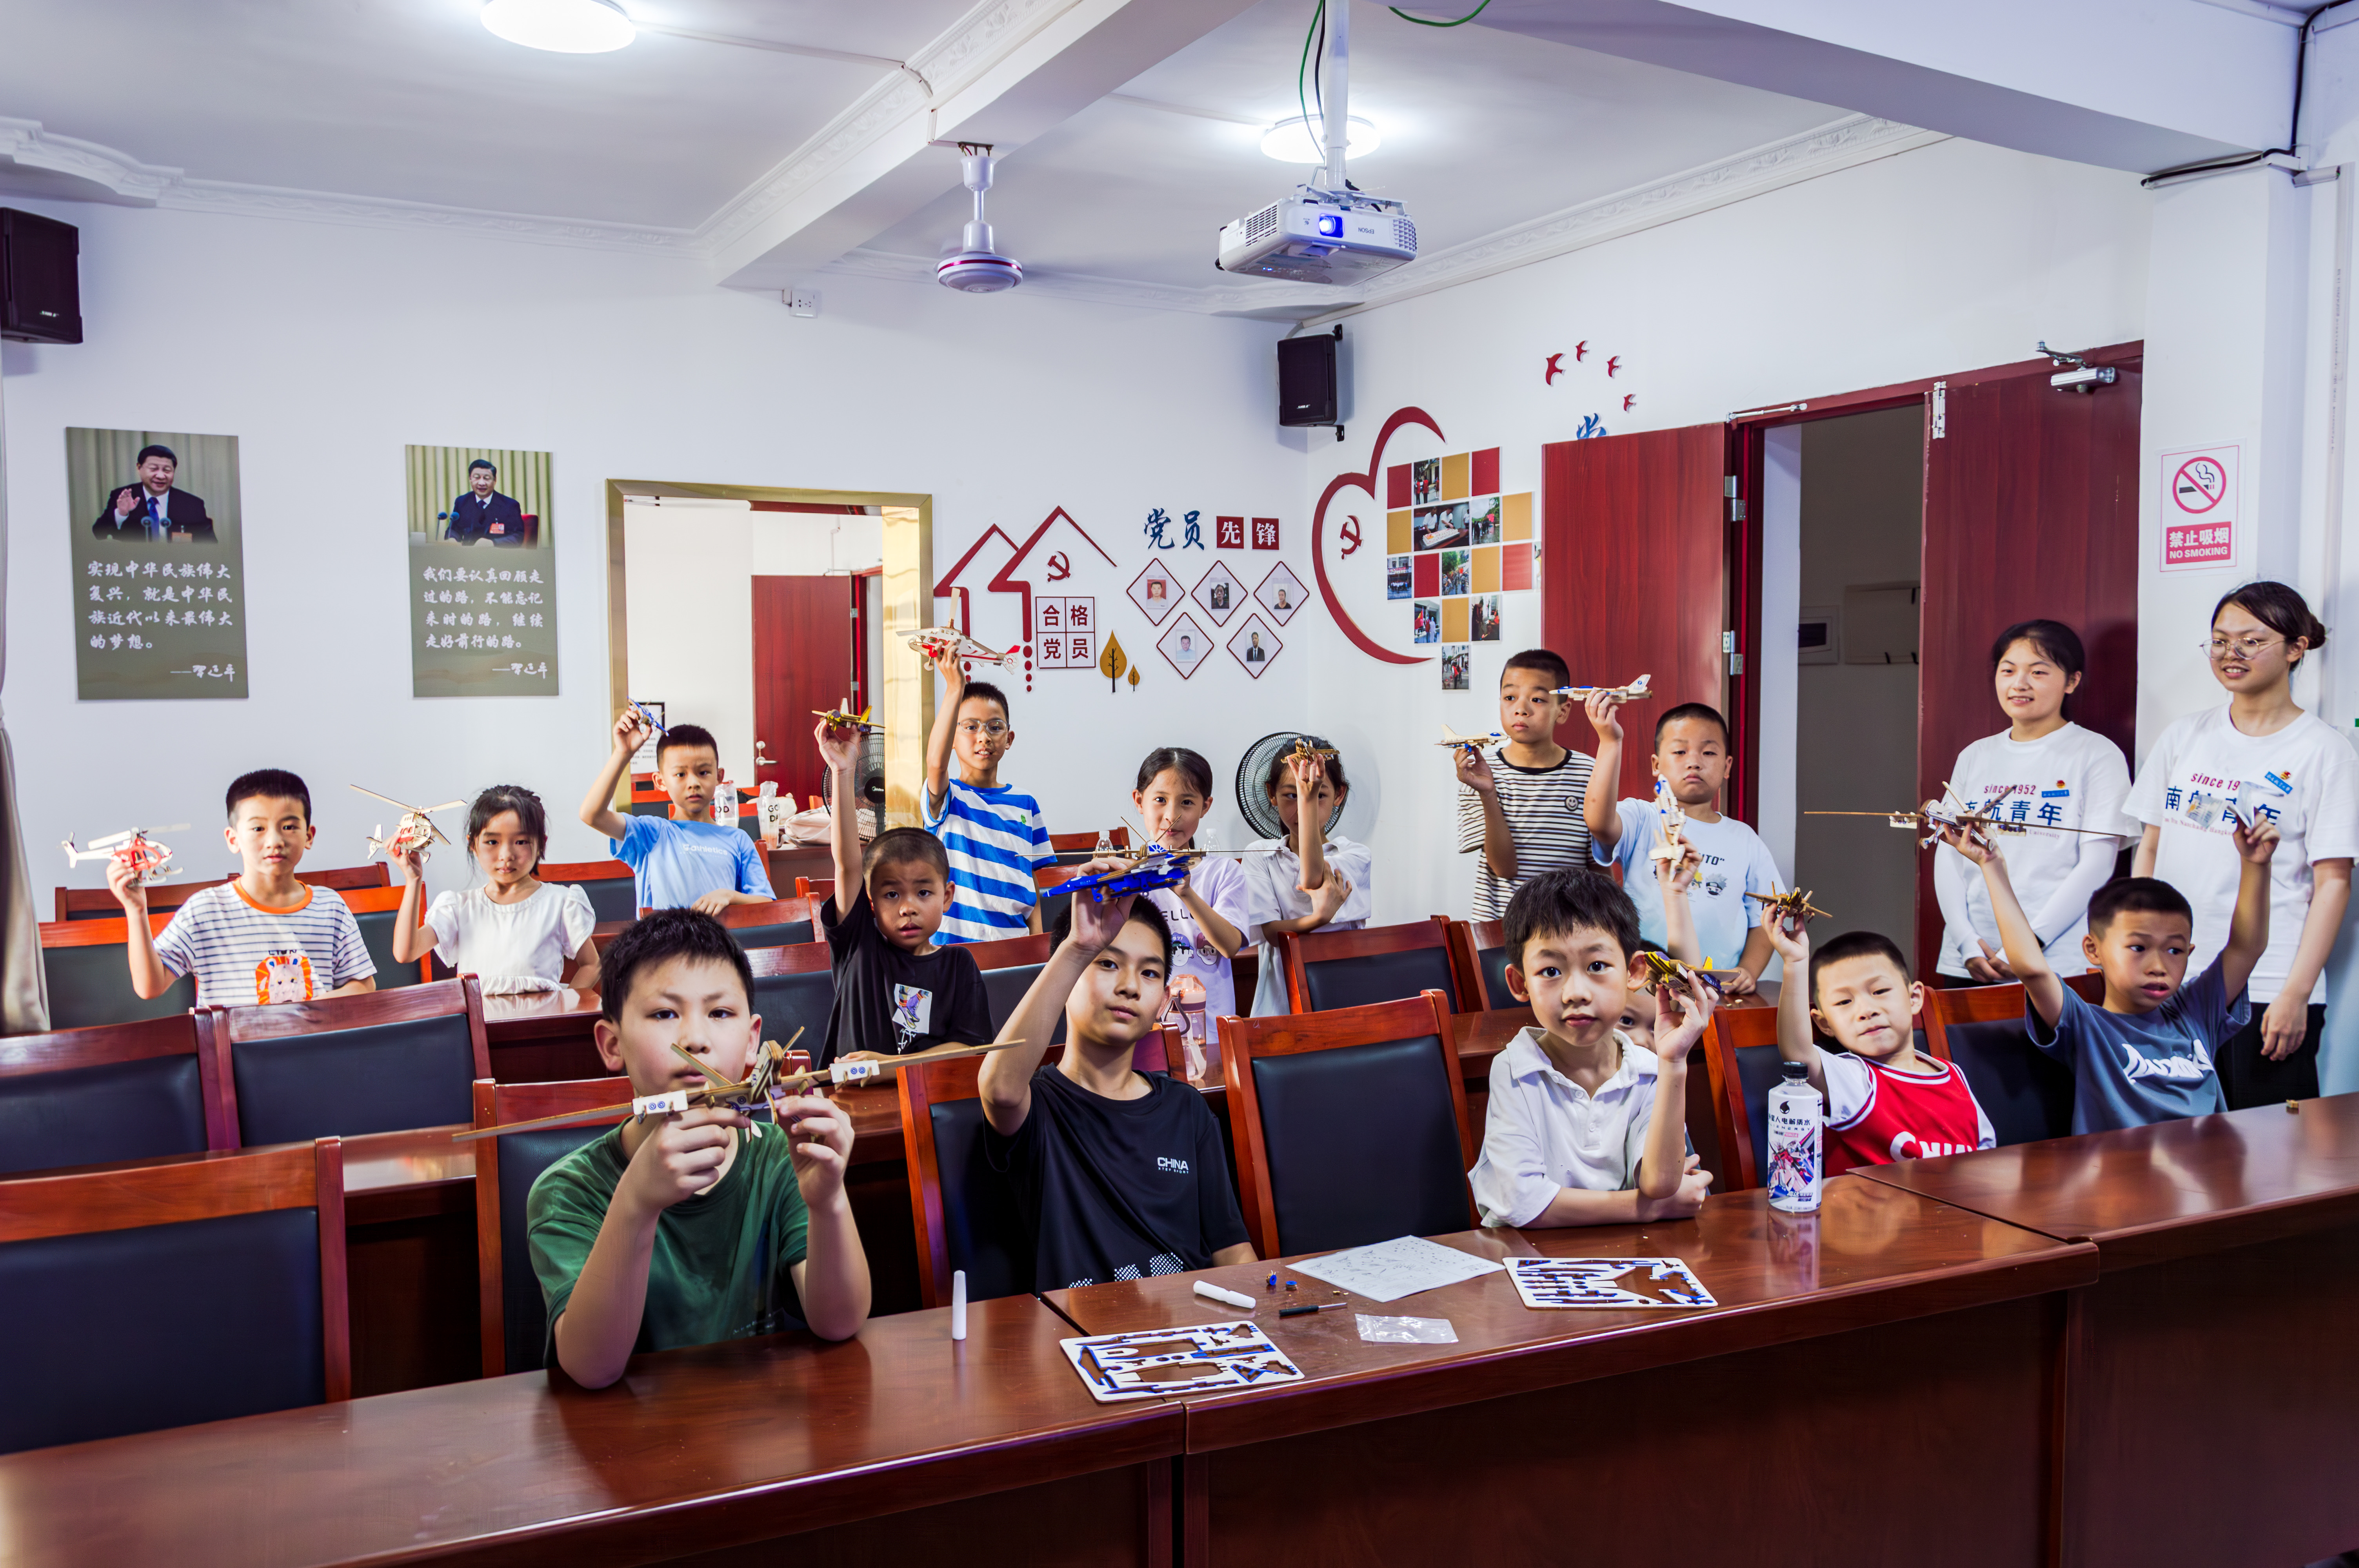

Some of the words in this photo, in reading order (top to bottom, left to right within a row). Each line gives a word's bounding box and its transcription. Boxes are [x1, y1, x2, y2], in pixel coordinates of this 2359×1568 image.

[1144, 507, 1277, 551] 党员先锋
[2169, 527, 2230, 548] 禁止吸烟
[2169, 550, 2183, 559] NO
[2185, 546, 2228, 558] SMOKING
[87, 560, 231, 579] 实现中华民族伟大
[423, 566, 544, 584] 我们要认真回顾走
[423, 590, 543, 605] 过的路，不能忘记
[88, 609, 233, 627] 族近代以来最伟大
[425, 610, 544, 628] 来时的路，继续
[1043, 604, 1089, 627] 合格
[89, 633, 153, 651] 的梦想。
[426, 633, 522, 649] 走好前行的路。
[1043, 638, 1088, 660] 党员
[2013, 784, 2036, 795] 1952
[2190, 773, 2224, 788] since
[2227, 779, 2241, 791] 19
[1157, 1157, 1189, 1171] CHINA
